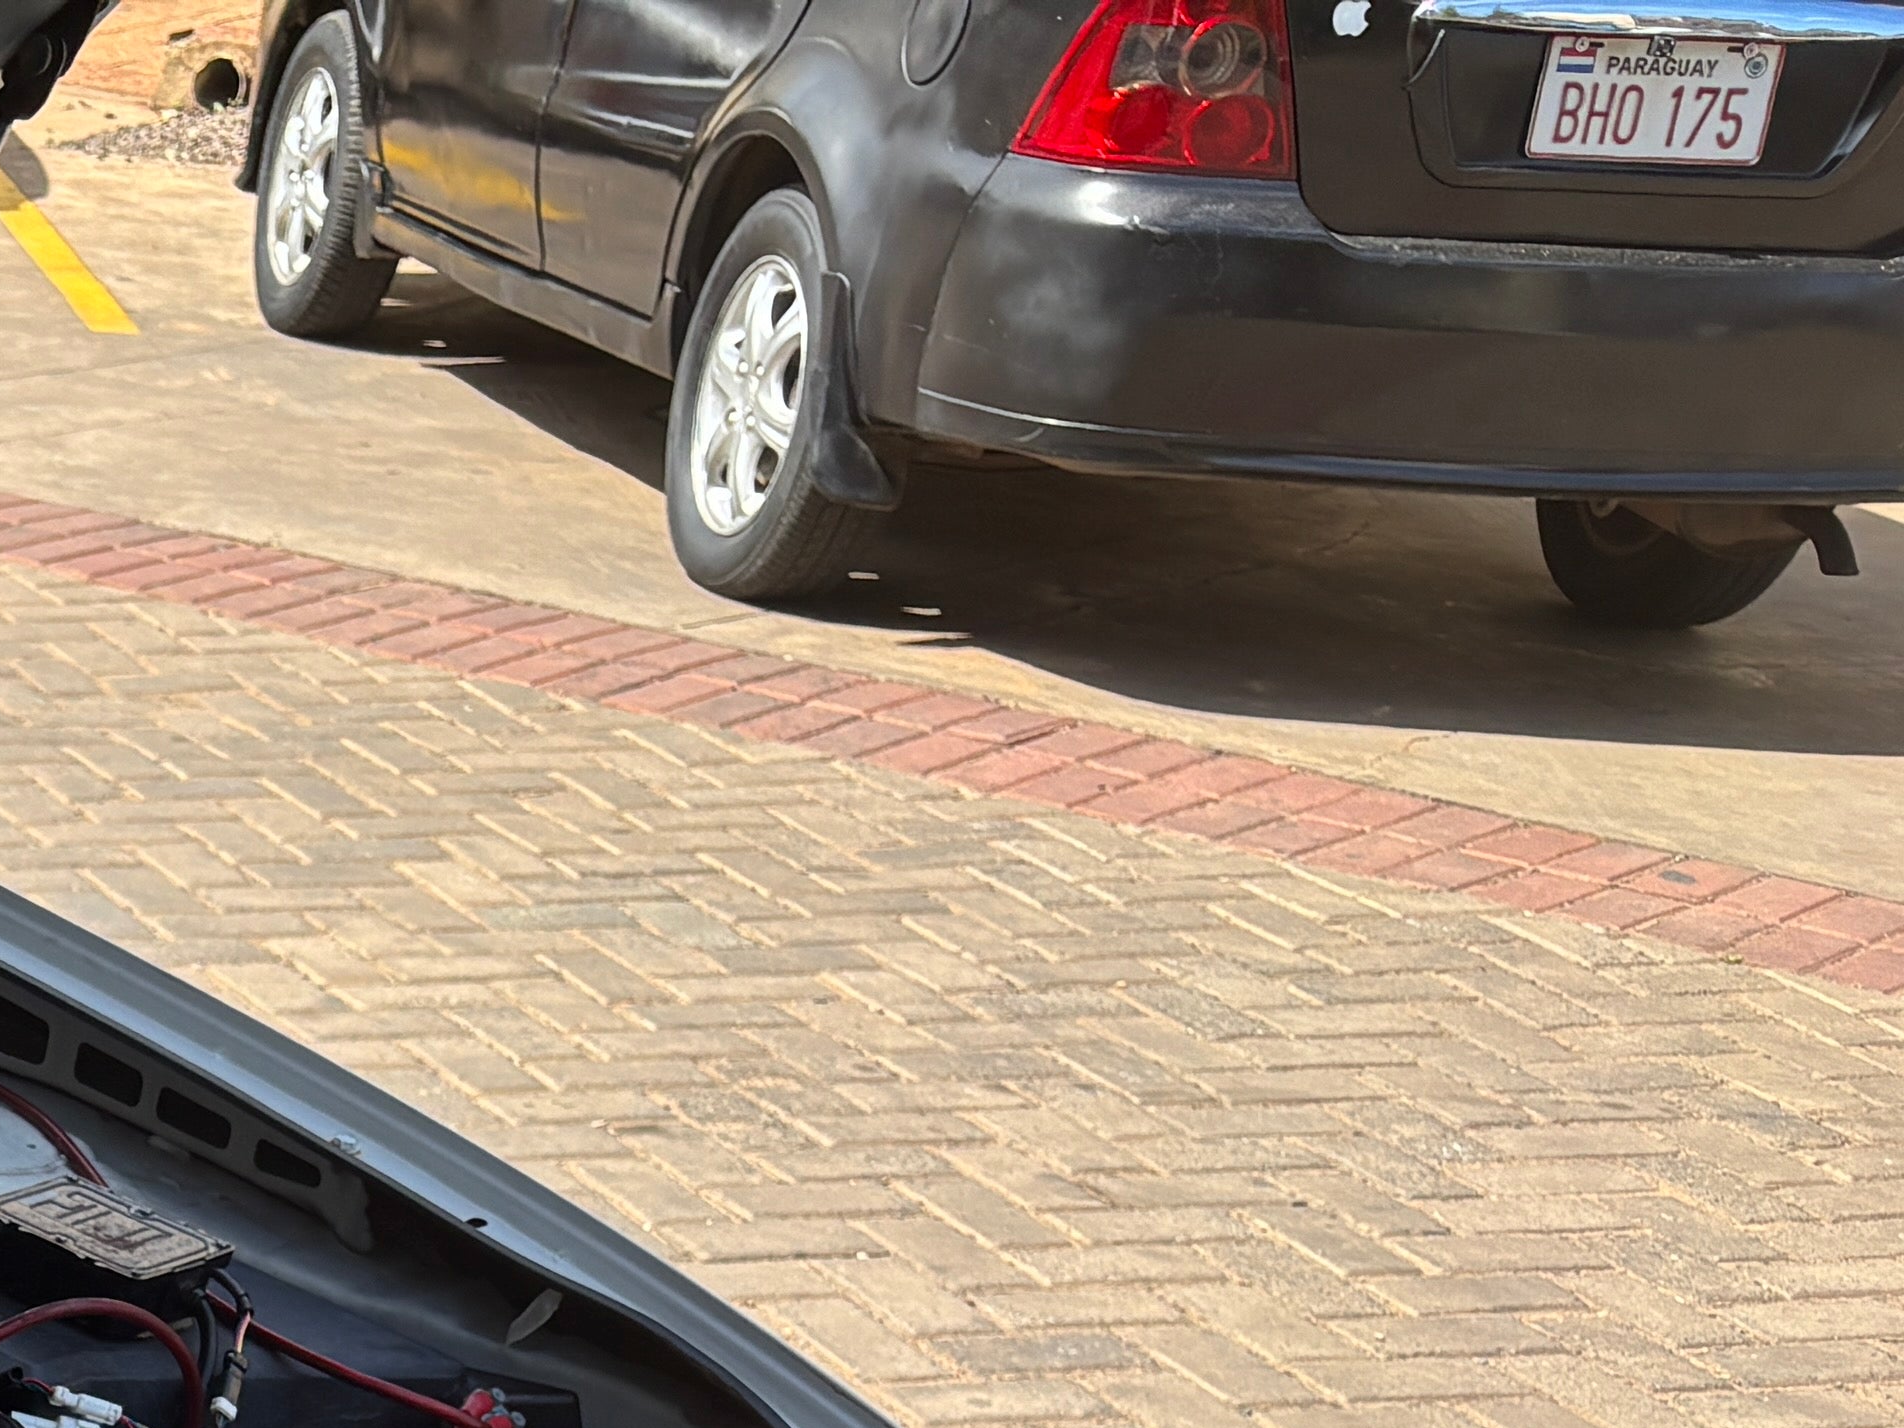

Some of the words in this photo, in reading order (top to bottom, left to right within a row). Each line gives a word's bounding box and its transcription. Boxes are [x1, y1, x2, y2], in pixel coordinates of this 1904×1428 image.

[1605, 55, 1720, 79] PARAGUAY
[1551, 81, 1645, 146] BHO
[1664, 86, 1750, 151] 175
